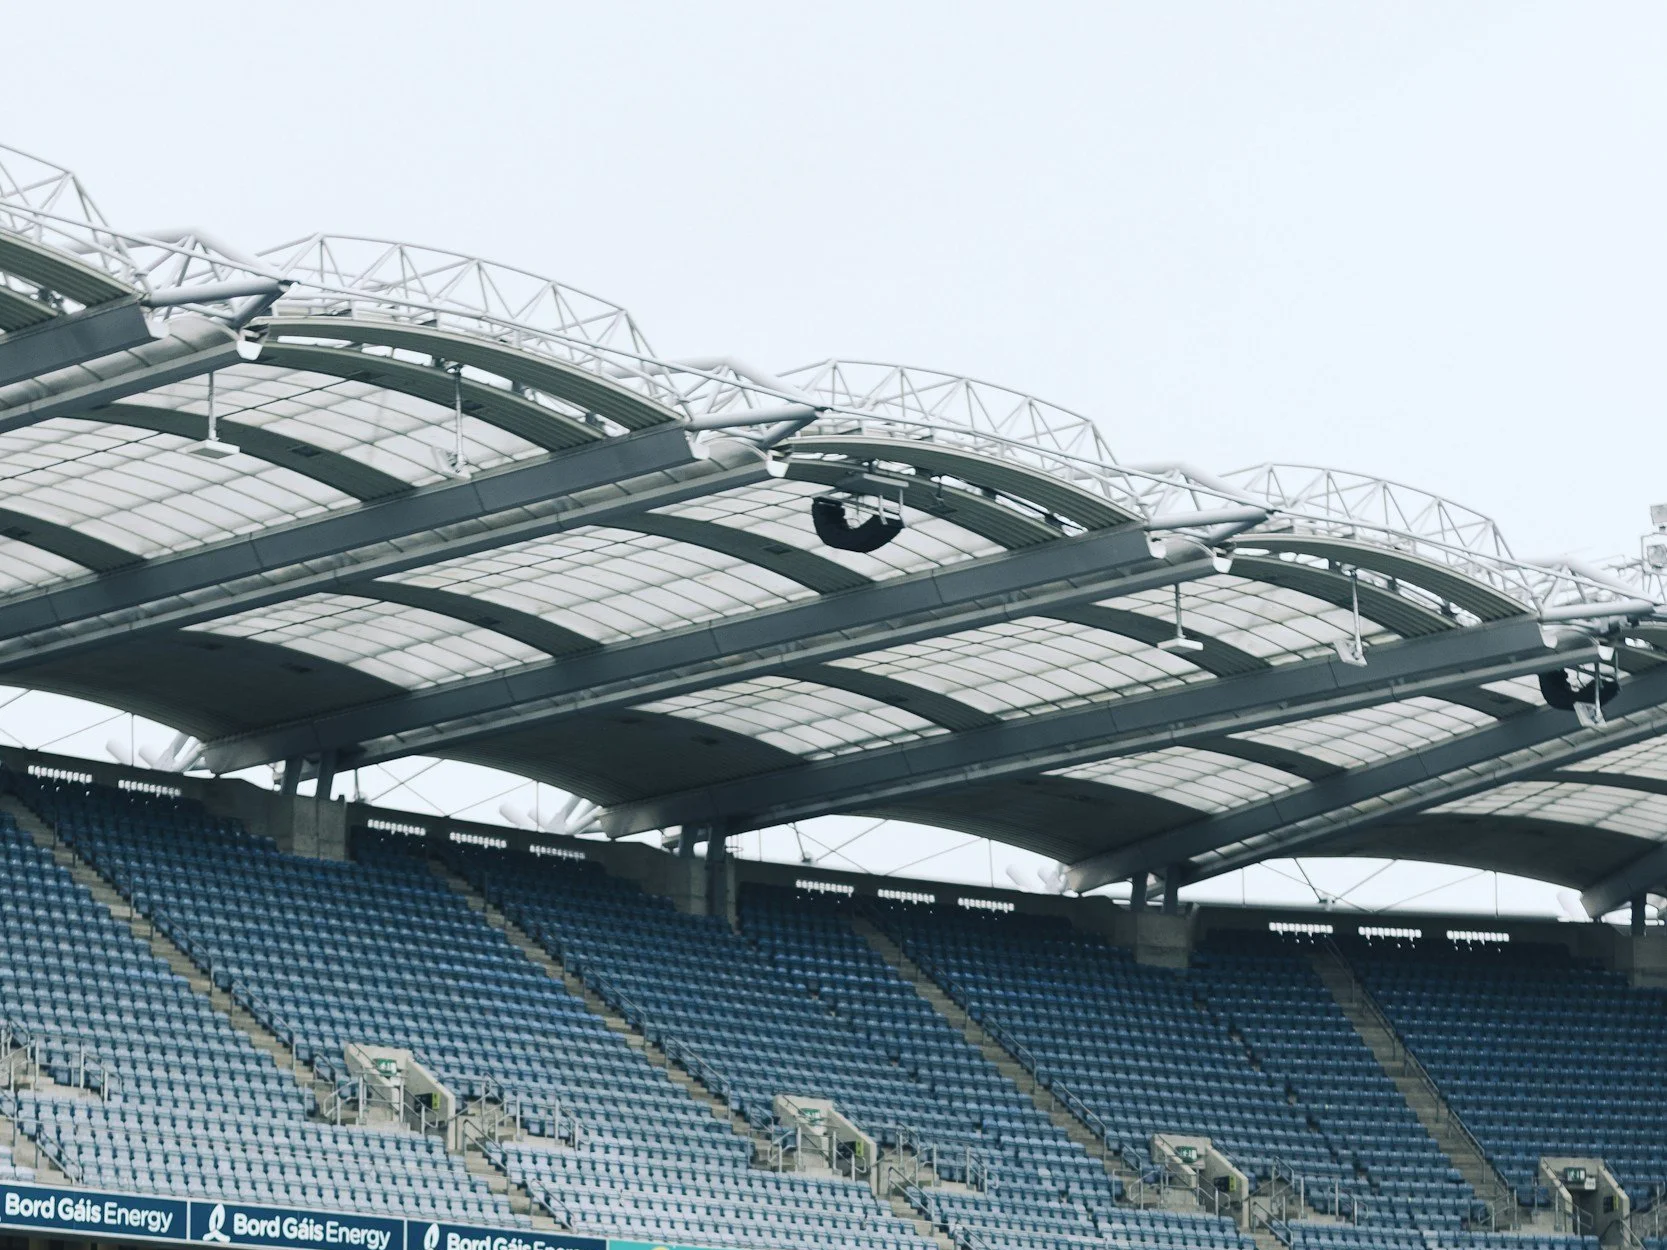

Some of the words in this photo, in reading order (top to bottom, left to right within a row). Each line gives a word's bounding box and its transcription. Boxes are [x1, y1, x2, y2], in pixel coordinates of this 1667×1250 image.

[5, 1192, 55, 1219] Bord
[58, 1197, 101, 1223] Gáis
[104, 1202, 173, 1233] Energy
[233, 1213, 280, 1238] Bord
[282, 1217, 324, 1241] Gáis
[326, 1221, 391, 1250] Energy
